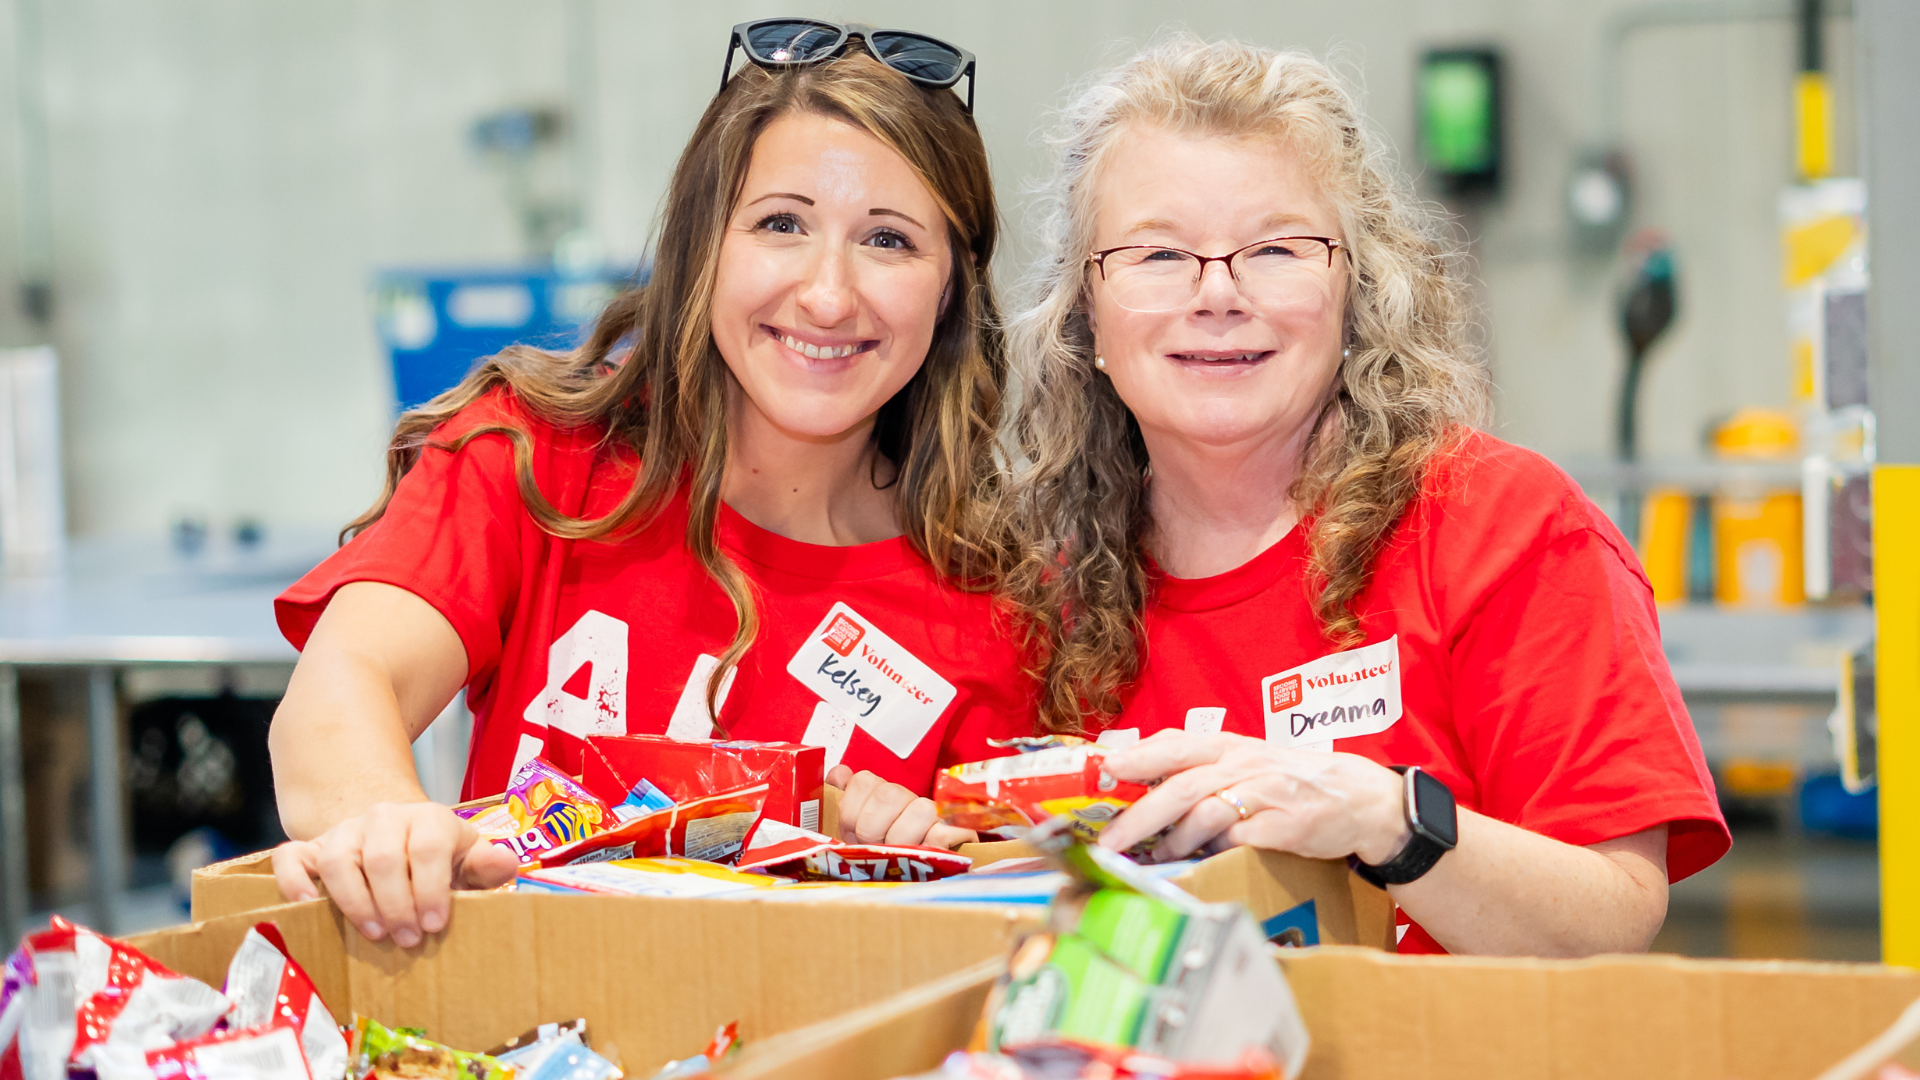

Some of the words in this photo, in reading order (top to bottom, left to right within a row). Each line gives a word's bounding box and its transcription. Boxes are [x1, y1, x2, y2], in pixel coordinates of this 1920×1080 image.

[816, 653, 882, 718] Kelsey
[860, 643, 934, 706] Volunteer
[1273, 679, 1297, 691] SECOND
[1306, 660, 1393, 690] Volunteer
[1290, 697, 1386, 737] Dreama
